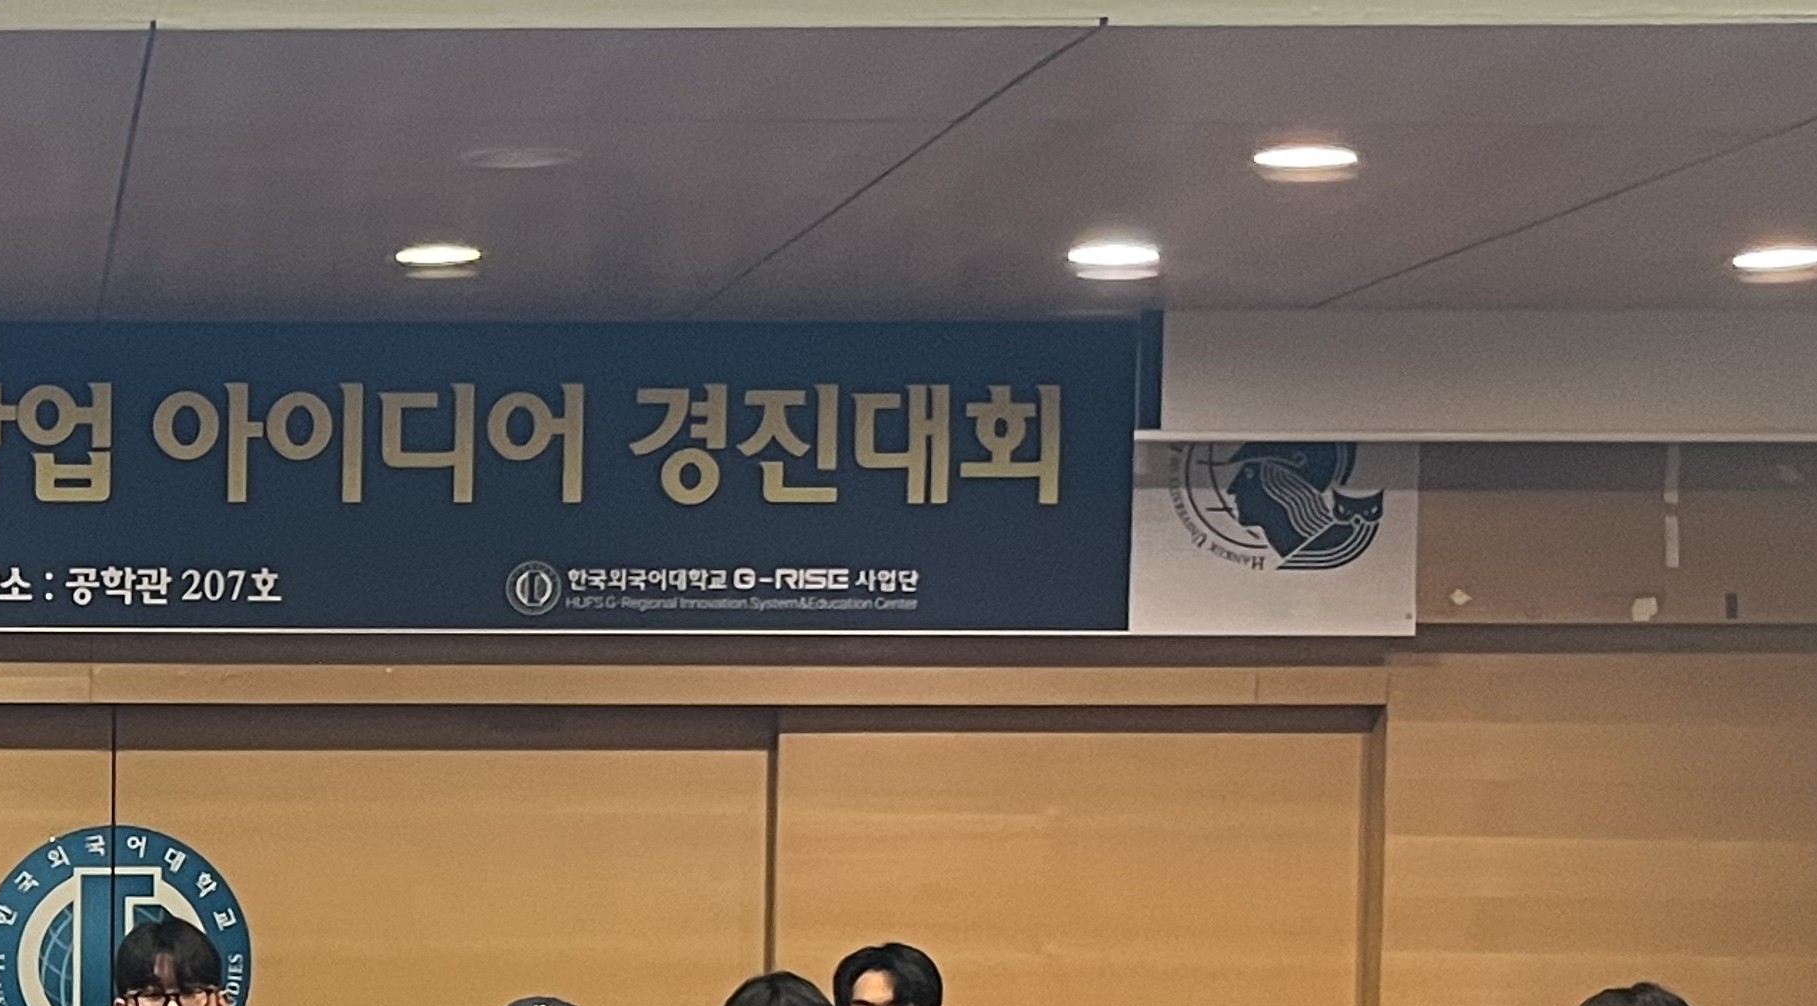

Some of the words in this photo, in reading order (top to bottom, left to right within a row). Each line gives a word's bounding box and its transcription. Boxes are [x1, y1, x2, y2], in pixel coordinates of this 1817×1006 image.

[151, 381, 584, 506] 아이디어
[627, 383, 1061, 507] 경진대회
[65, 566, 173, 606] 공학관
[181, 568, 282, 602] 207호
[567, 568, 727, 591] 한국외국어대학교
[733, 567, 850, 590] G-RISE
[855, 569, 919, 592] 사업단
